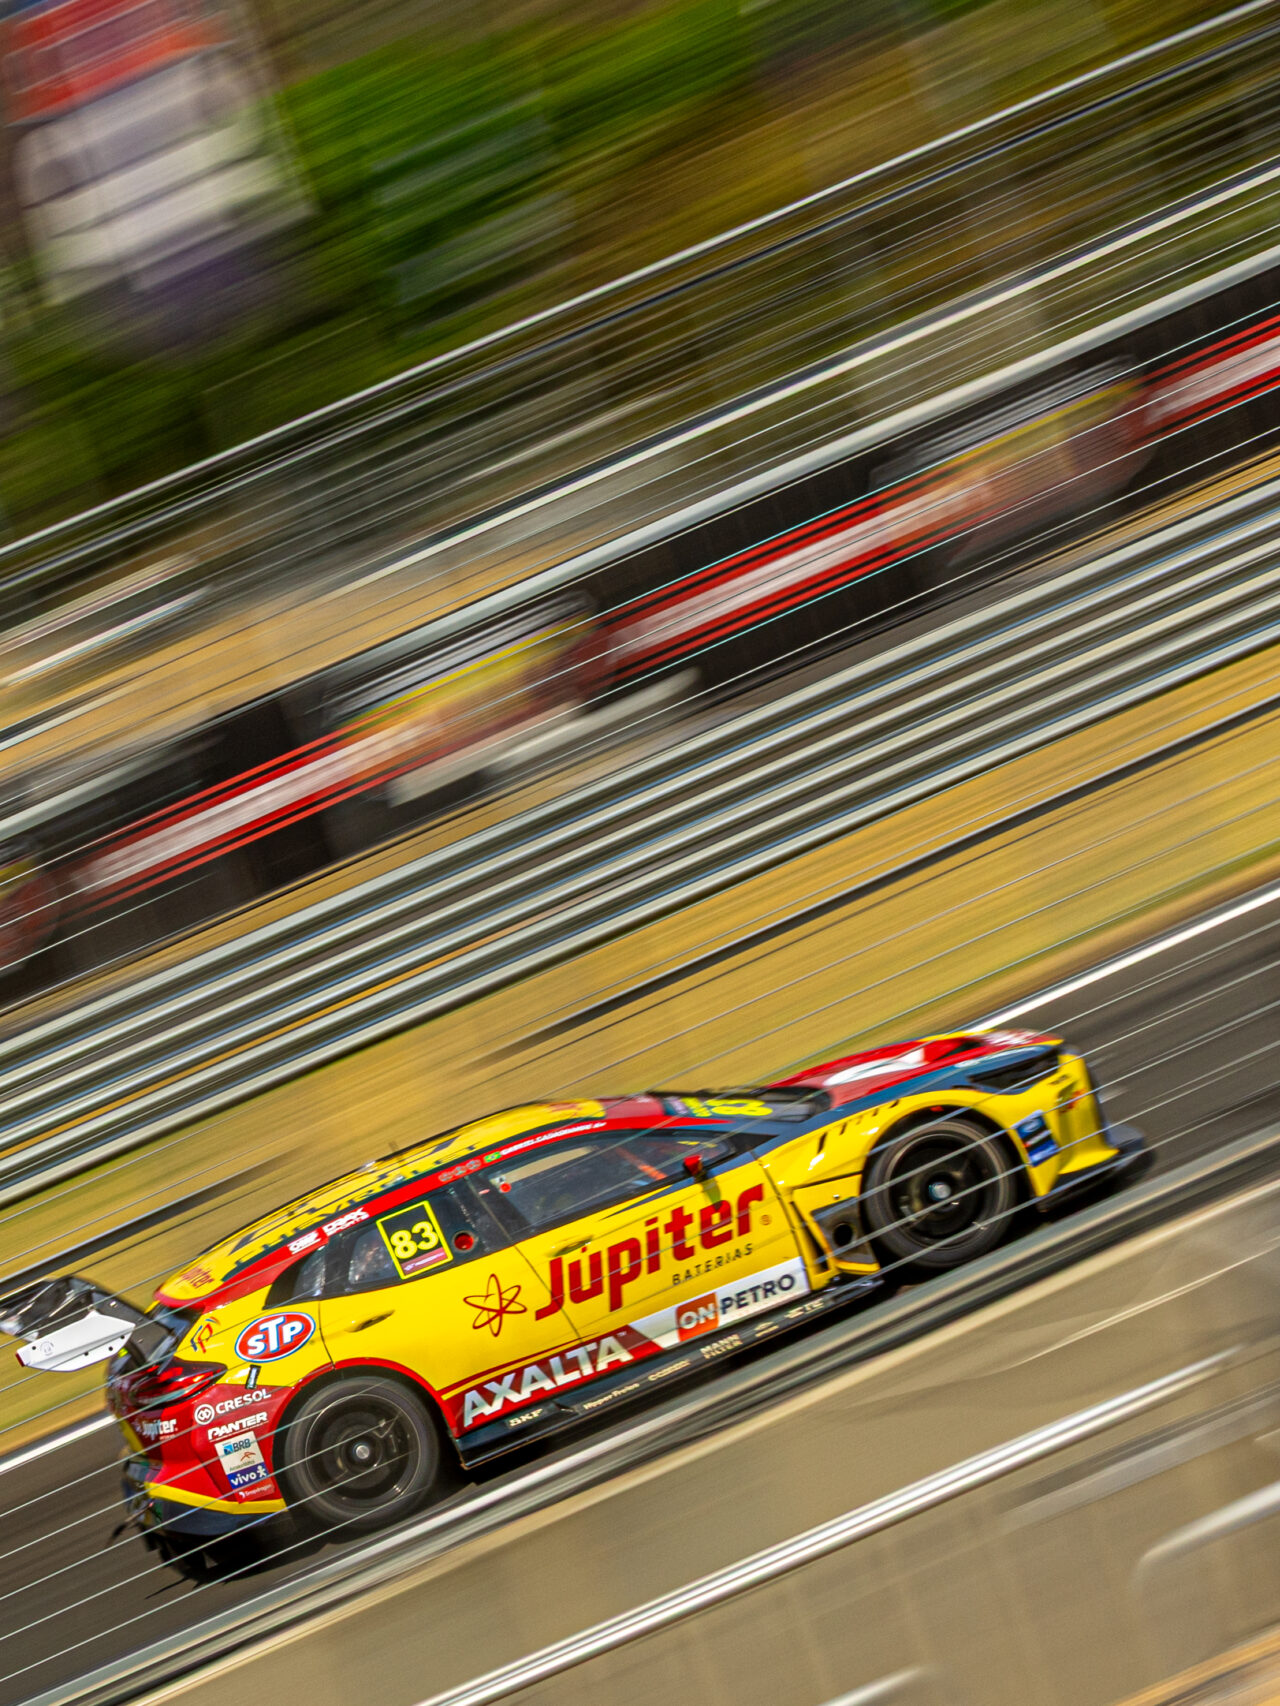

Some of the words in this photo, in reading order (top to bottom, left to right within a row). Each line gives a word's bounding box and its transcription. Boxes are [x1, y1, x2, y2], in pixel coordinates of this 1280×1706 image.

[390, 1221, 438, 1260] 83
[671, 1243, 754, 1287] BATERIAS
[246, 1315, 305, 1357] STP
[463, 1335, 634, 1428] AXALTA
[215, 1388, 272, 1415] CRESOL
[208, 1411, 269, 1437] PANTER
[508, 1407, 543, 1428] SKF
[232, 1437, 252, 1454] BRB
[230, 1469, 258, 1489] vivo
